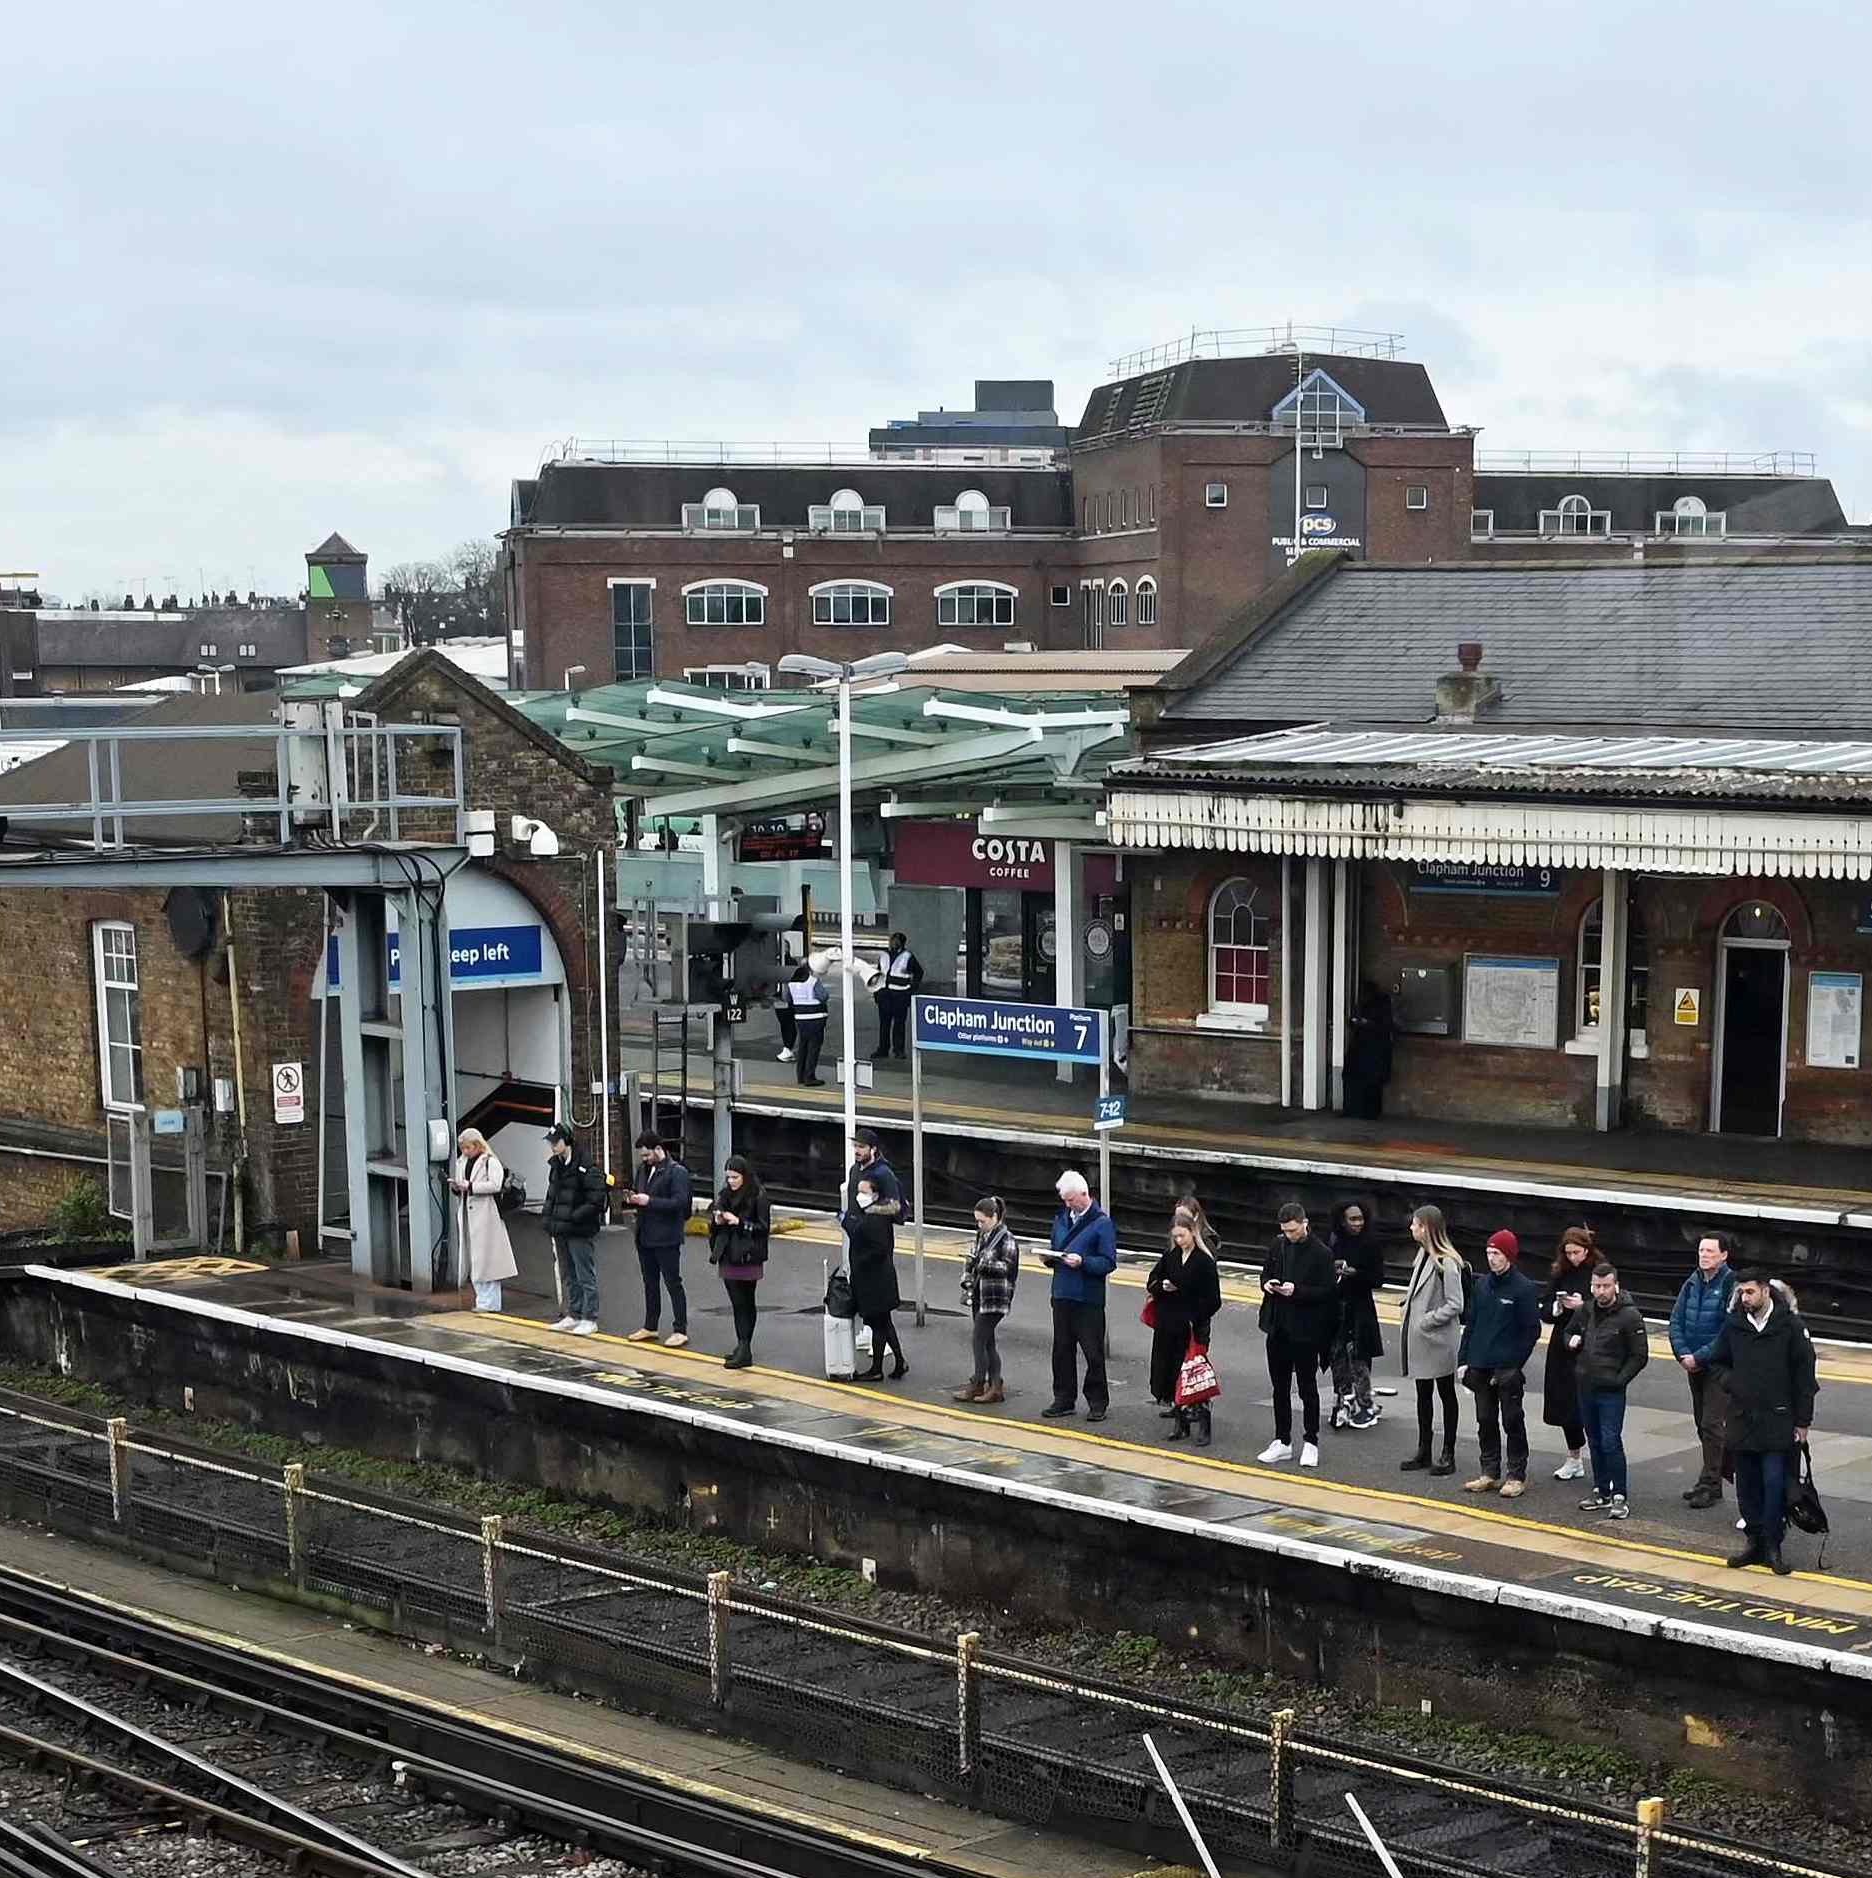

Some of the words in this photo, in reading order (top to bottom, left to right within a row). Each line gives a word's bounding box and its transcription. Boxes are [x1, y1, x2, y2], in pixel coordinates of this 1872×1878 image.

[1302, 518, 1333, 535] pcs
[1308, 537, 1360, 546] COMMERCIAL
[971, 838, 1046, 865] COSTA
[989, 867, 1030, 879] COFFEE
[1417, 861, 1469, 877] Clapham
[1471, 863, 1525, 878] Junction
[1540, 869, 1551, 888] 9
[448, 949, 479, 964] eep
[483, 943, 510, 961] left
[729, 993, 739, 1006] W
[727, 1008, 742, 1021] 122
[924, 1005, 987, 1029] Clapham
[990, 1010, 1055, 1035] Junction
[1073, 1025, 1088, 1050] 7
[1099, 1101, 1121, 1119] 7-12
[1573, 1574, 1665, 1596] GAP
[1657, 1590, 1741, 1614] THE
[1742, 1607, 1858, 1635] MIND
